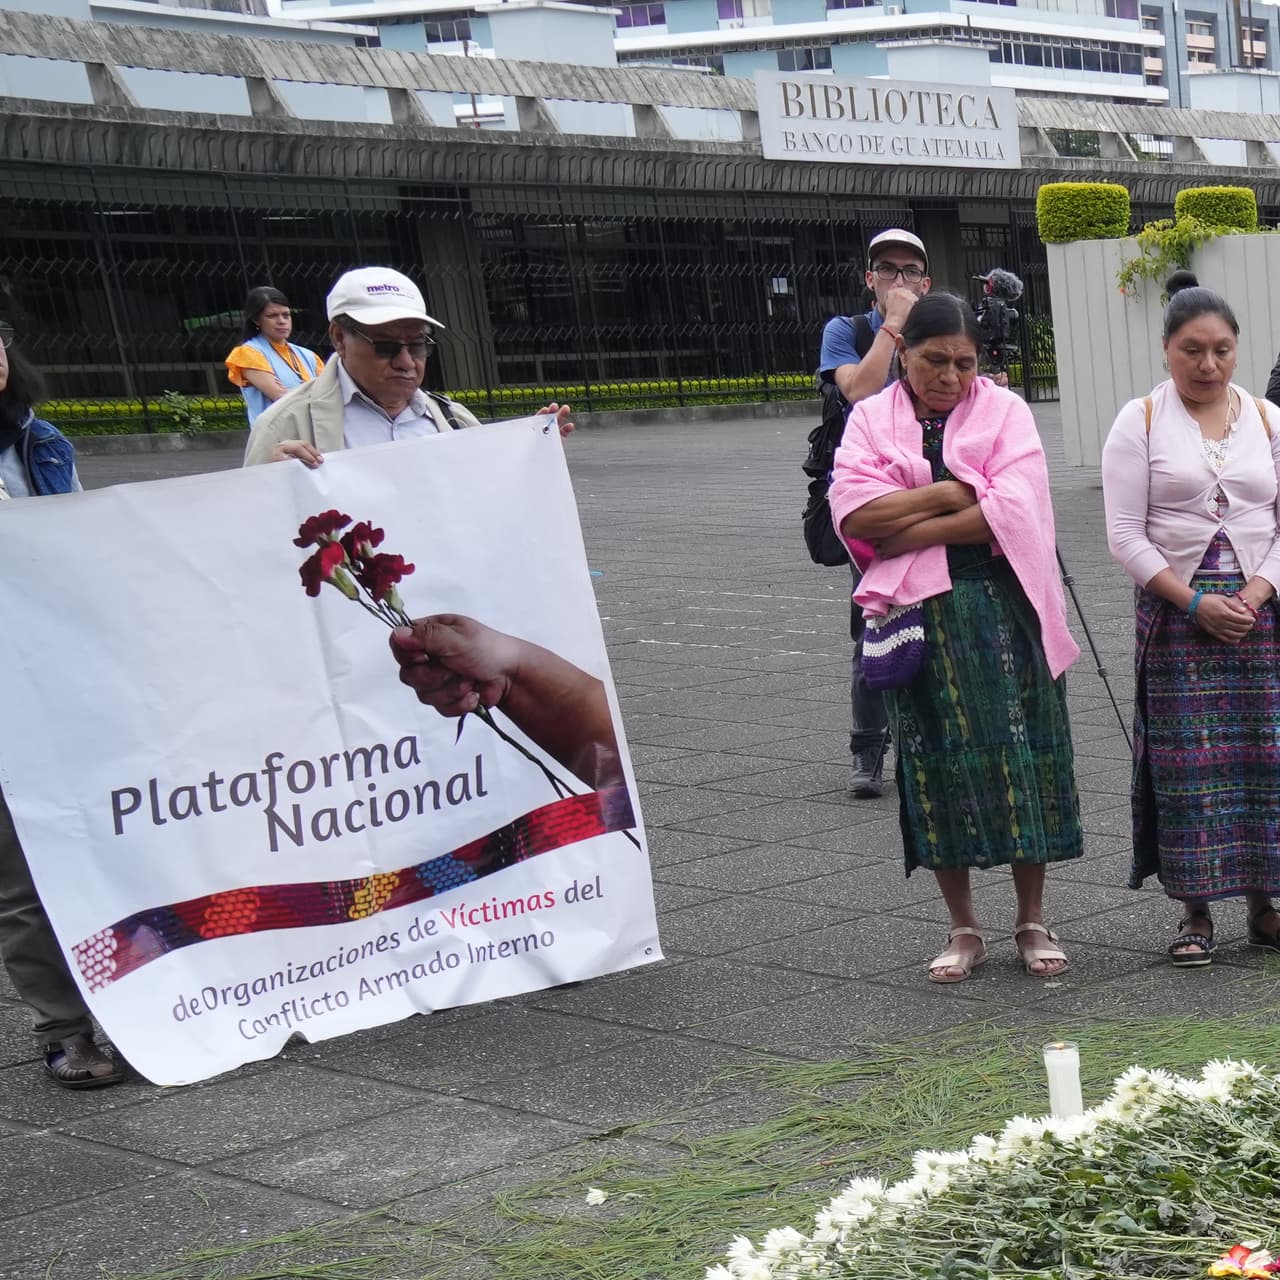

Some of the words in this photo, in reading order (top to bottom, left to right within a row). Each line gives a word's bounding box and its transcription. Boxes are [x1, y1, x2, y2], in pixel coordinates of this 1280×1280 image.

[778, 81, 1002, 130] BIBLIOTECA
[784, 131, 853, 153] BANCO
[859, 134, 884, 154] DE
[890, 136, 1006, 160] GUATEMALA
[367, 284, 400, 293] metro
[110, 734, 421, 836] Plataforma
[265, 754, 488, 852] Nacional
[407, 913, 438, 941] de
[440, 885, 556, 930] Víctimas
[563, 874, 603, 905] del
[238, 987, 350, 1041] Conflicto
[358, 951, 461, 1001] Armado
[467, 926, 556, 967] Interno
